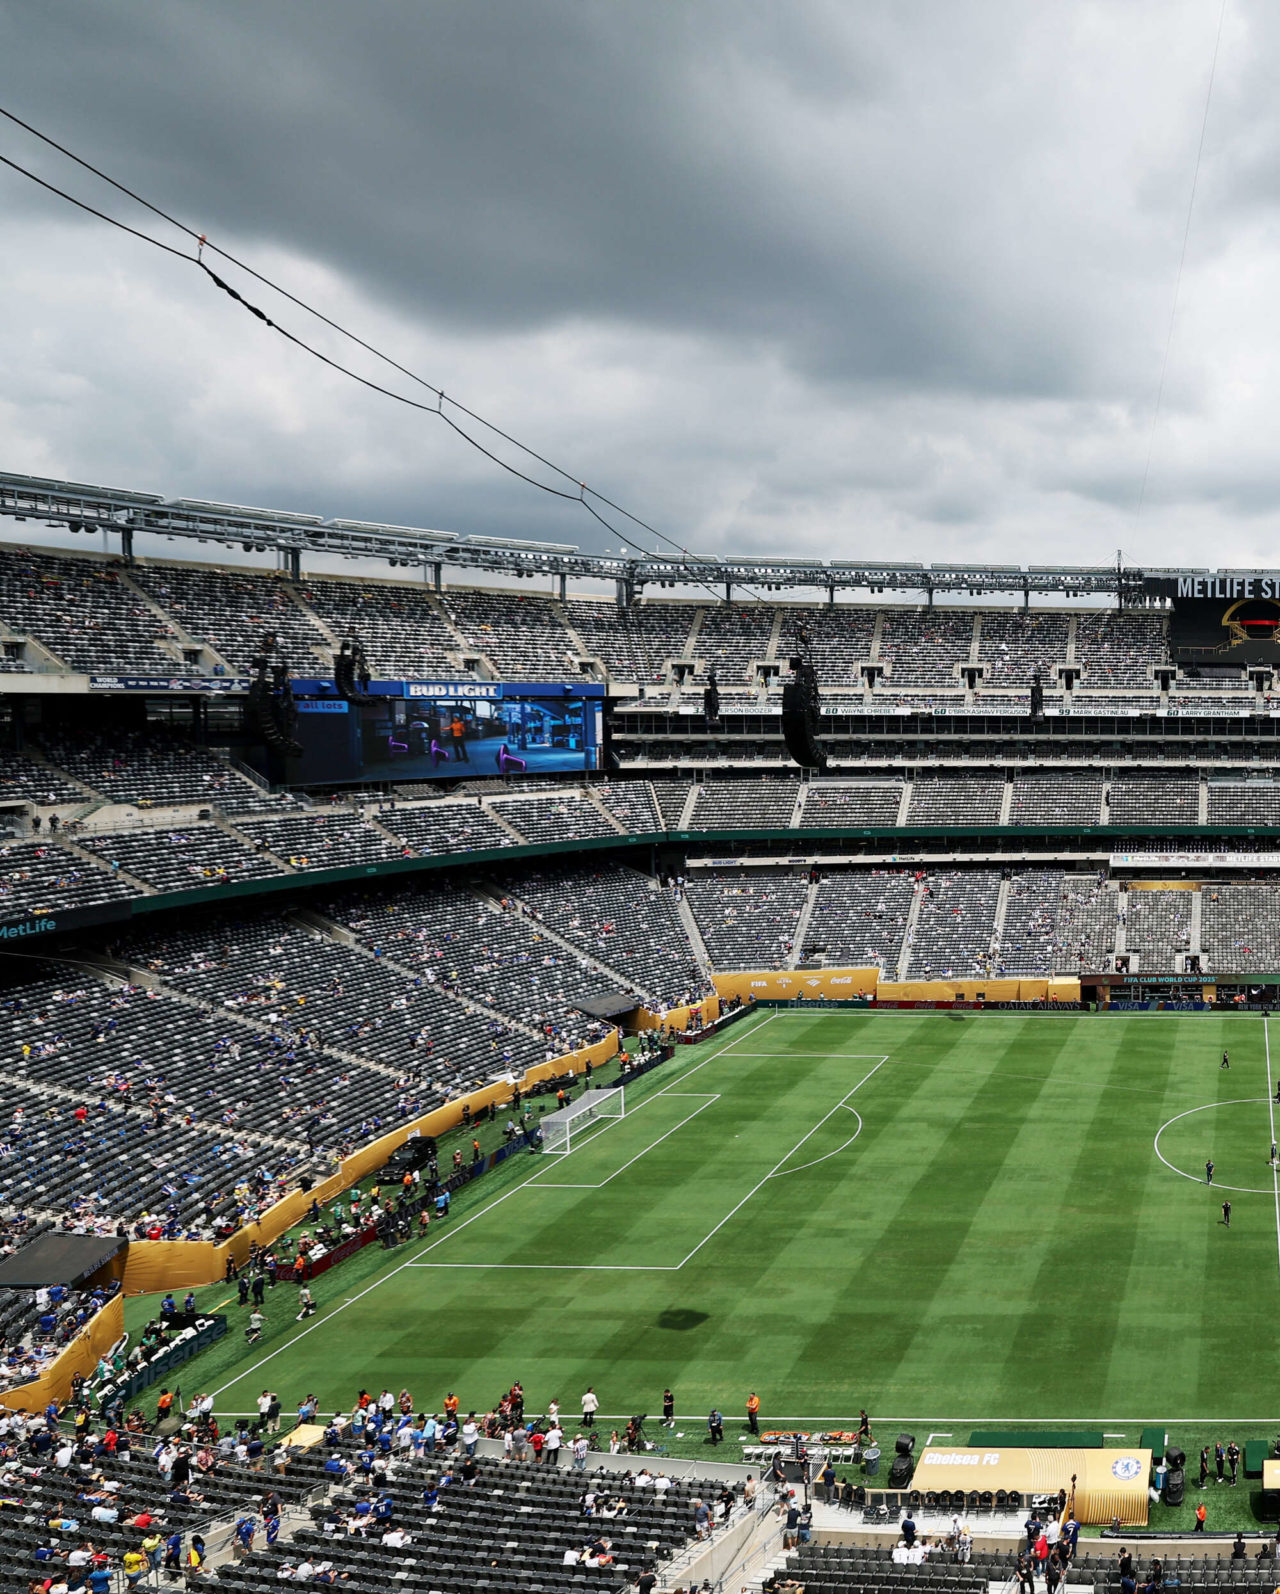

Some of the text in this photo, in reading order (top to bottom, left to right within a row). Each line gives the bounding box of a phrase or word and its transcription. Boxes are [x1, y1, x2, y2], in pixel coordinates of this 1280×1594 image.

[1178, 578, 1254, 598] METLIFE
[409, 683, 497, 697] BUD LIGHT
[321, 701, 343, 709] lots
[825, 707, 838, 715] 80
[0, 919, 56, 939] MetLife
[788, 1000, 839, 1008] Hisense
[999, 1002, 1080, 1010] QATAR AIRWAYS
[1118, 1002, 1140, 1010] VISA
[1173, 1002, 1194, 1010] VISA
[131, 1323, 226, 1397] Hisense
[923, 1452, 1000, 1466] Chelsea FC
